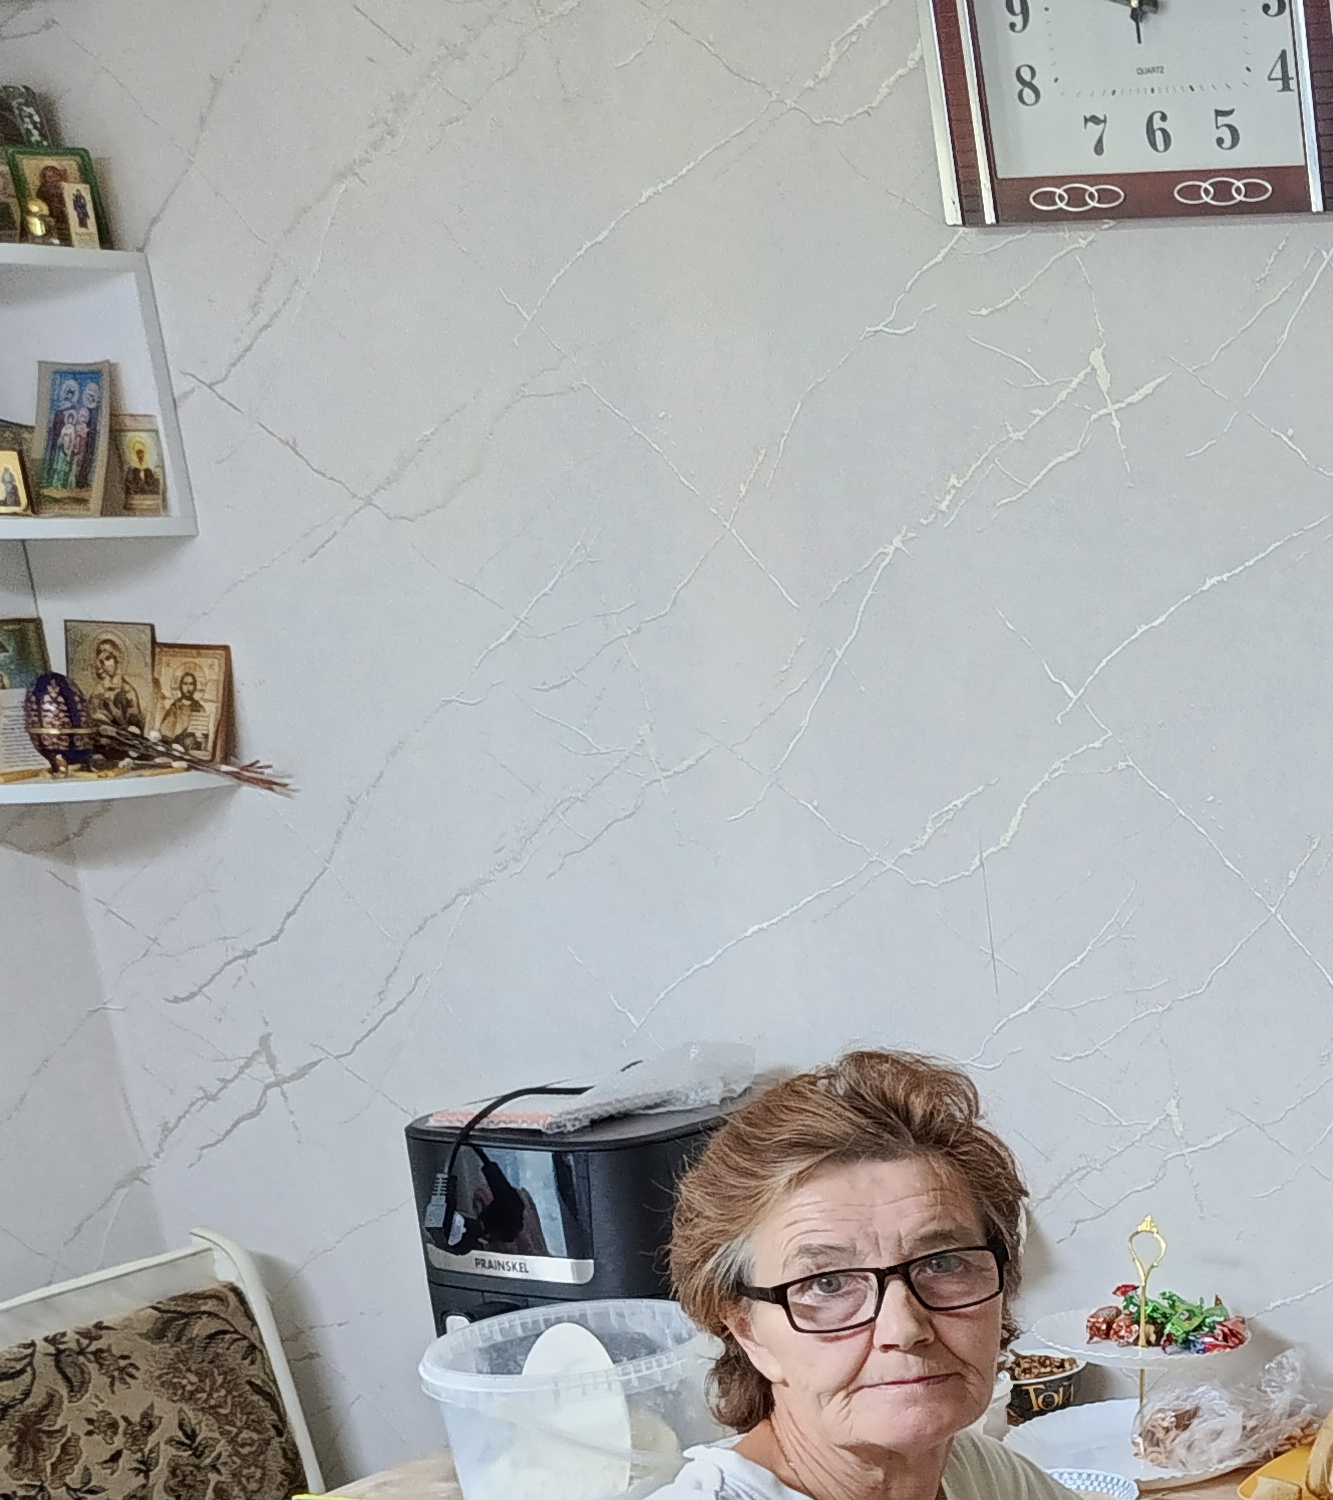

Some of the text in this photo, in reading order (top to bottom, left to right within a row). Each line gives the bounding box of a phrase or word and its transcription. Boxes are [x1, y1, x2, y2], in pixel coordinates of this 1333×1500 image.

[1005, 0, 1030, 33] 9
[1015, 63, 1041, 107] 8
[1136, 65, 1165, 76] QUARTZ
[1267, 48, 1295, 93] 4
[1083, 108, 1241, 157] 7 6 5
[474, 1257, 529, 1274] PRAINSKEL
